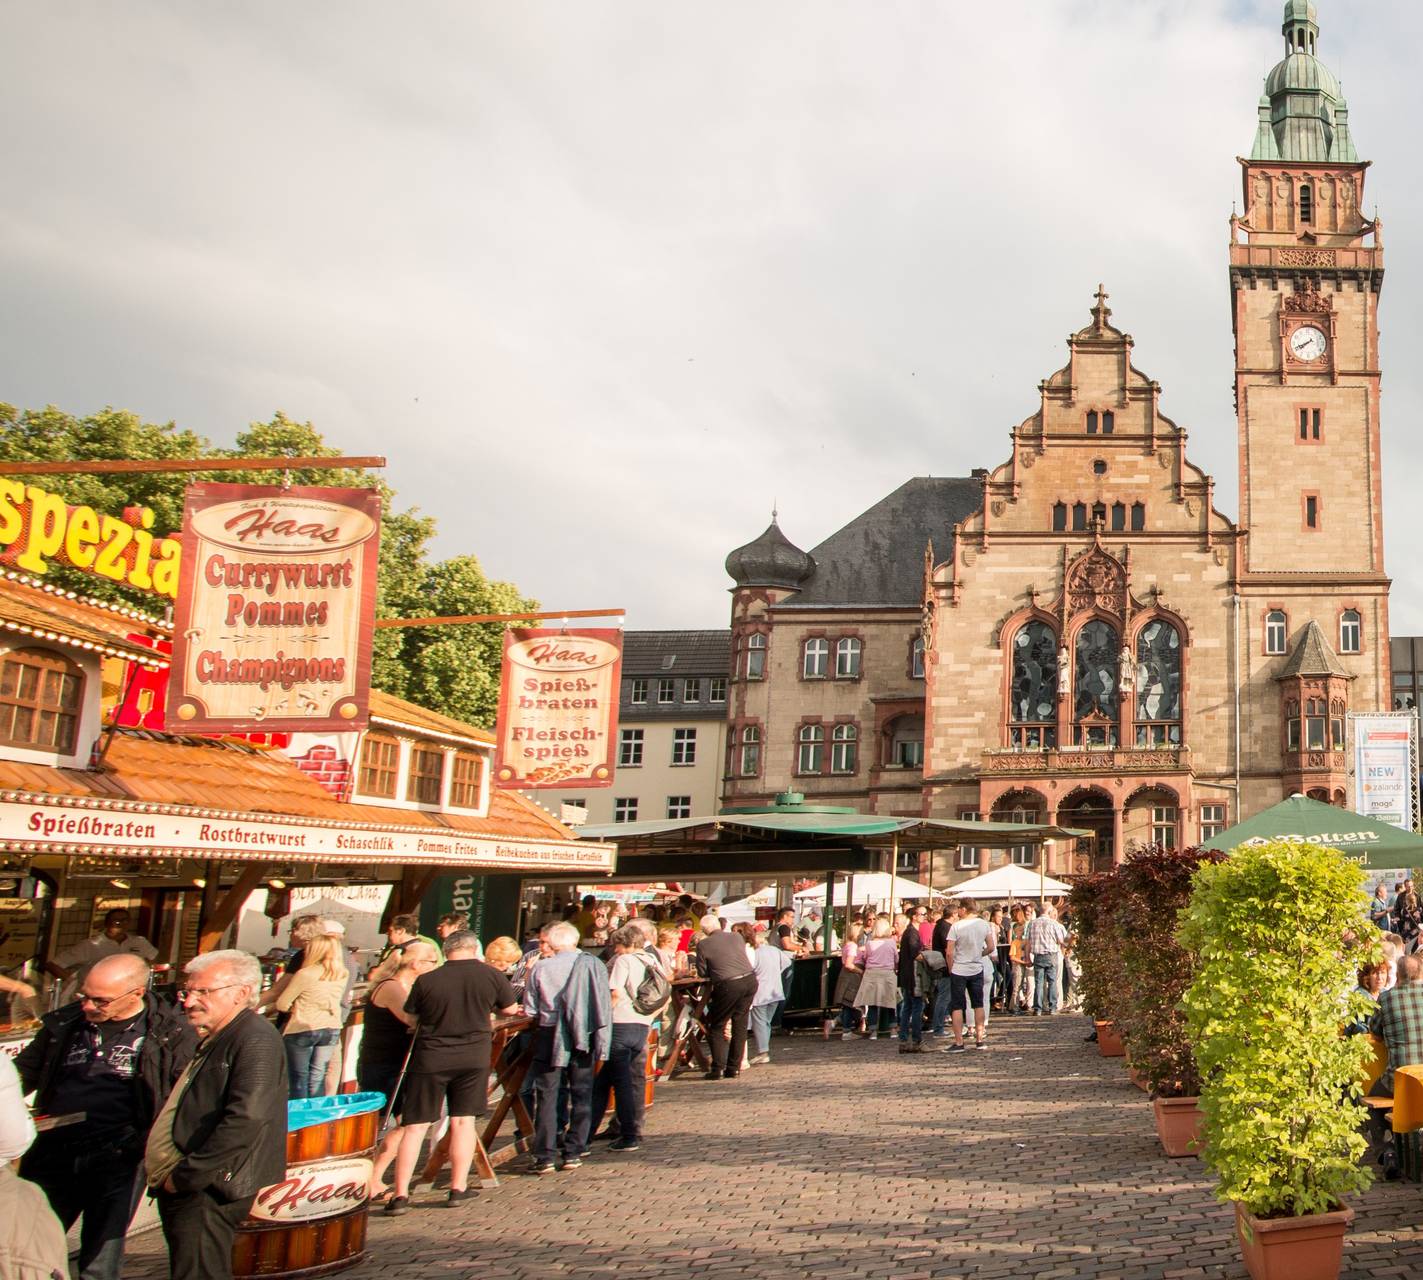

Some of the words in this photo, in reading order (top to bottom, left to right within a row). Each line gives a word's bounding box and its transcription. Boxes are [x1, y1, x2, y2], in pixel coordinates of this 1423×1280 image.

[224, 508, 340, 543] Haas
[205, 554, 353, 596] Currywurst
[225, 593, 328, 628] Pommes
[526, 644, 598, 664] Haas
[196, 650, 345, 691] Champignons
[523, 677, 598, 694] Spieß-
[518, 696, 598, 709] braten
[511, 726, 603, 741] Fleisch-
[523, 743, 589, 760] spieß
[1368, 767, 1394, 777] NEW
[1373, 783, 1404, 791] zalando
[28, 812, 156, 838] Spießbraten
[200, 824, 306, 846] Rostbratwurst
[336, 834, 394, 850] Schaschlik
[417, 839, 452, 854] Pommes
[454, 843, 478, 856] Frites
[1275, 831, 1380, 845] Bolten
[257, 1176, 367, 1216] Haas
